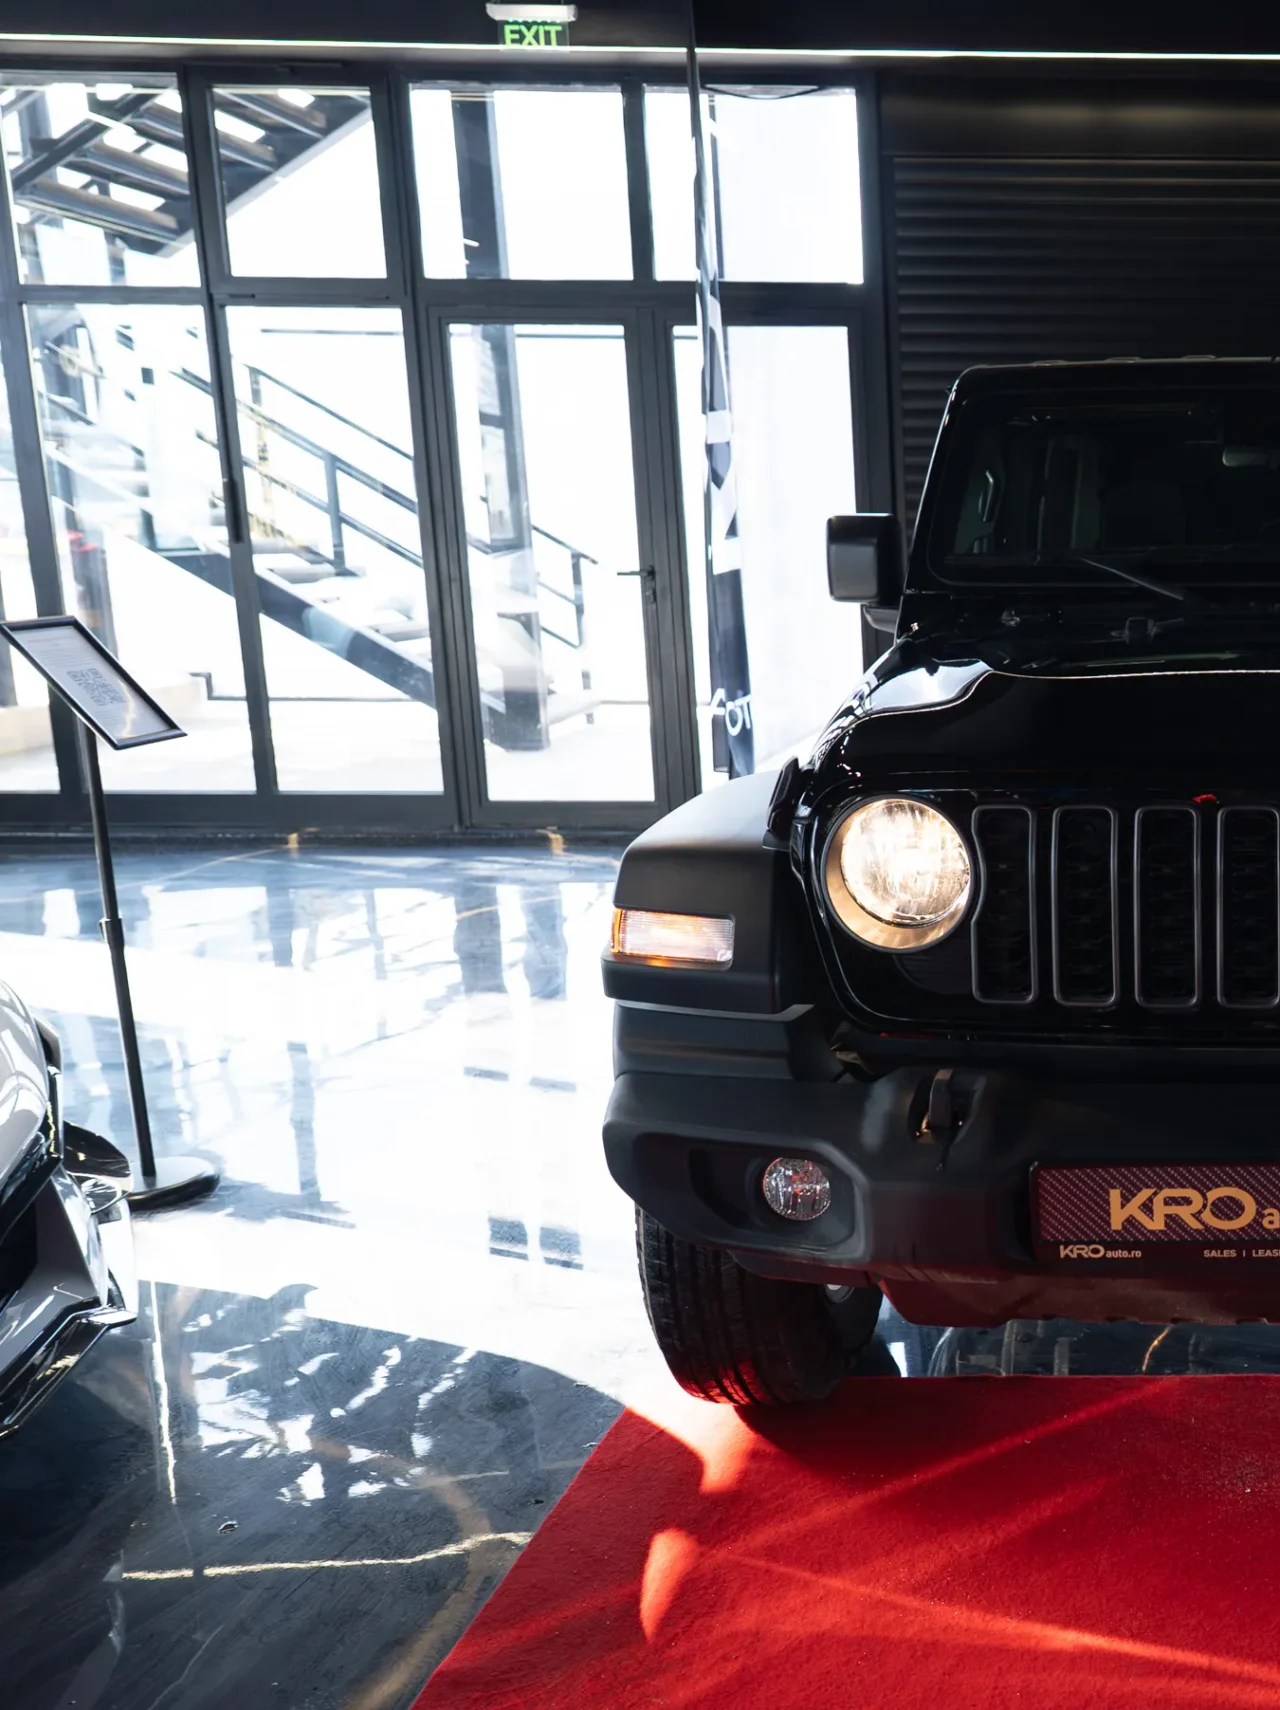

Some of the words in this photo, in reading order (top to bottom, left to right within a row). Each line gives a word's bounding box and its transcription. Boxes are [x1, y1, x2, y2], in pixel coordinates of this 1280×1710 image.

[504, 24, 562, 47] EXIT
[1109, 1186, 1257, 1231] KRO
[1059, 1244, 1105, 1259] KRO
[1105, 1248, 1142, 1259] auto.ro
[1203, 1249, 1237, 1258] SALES
